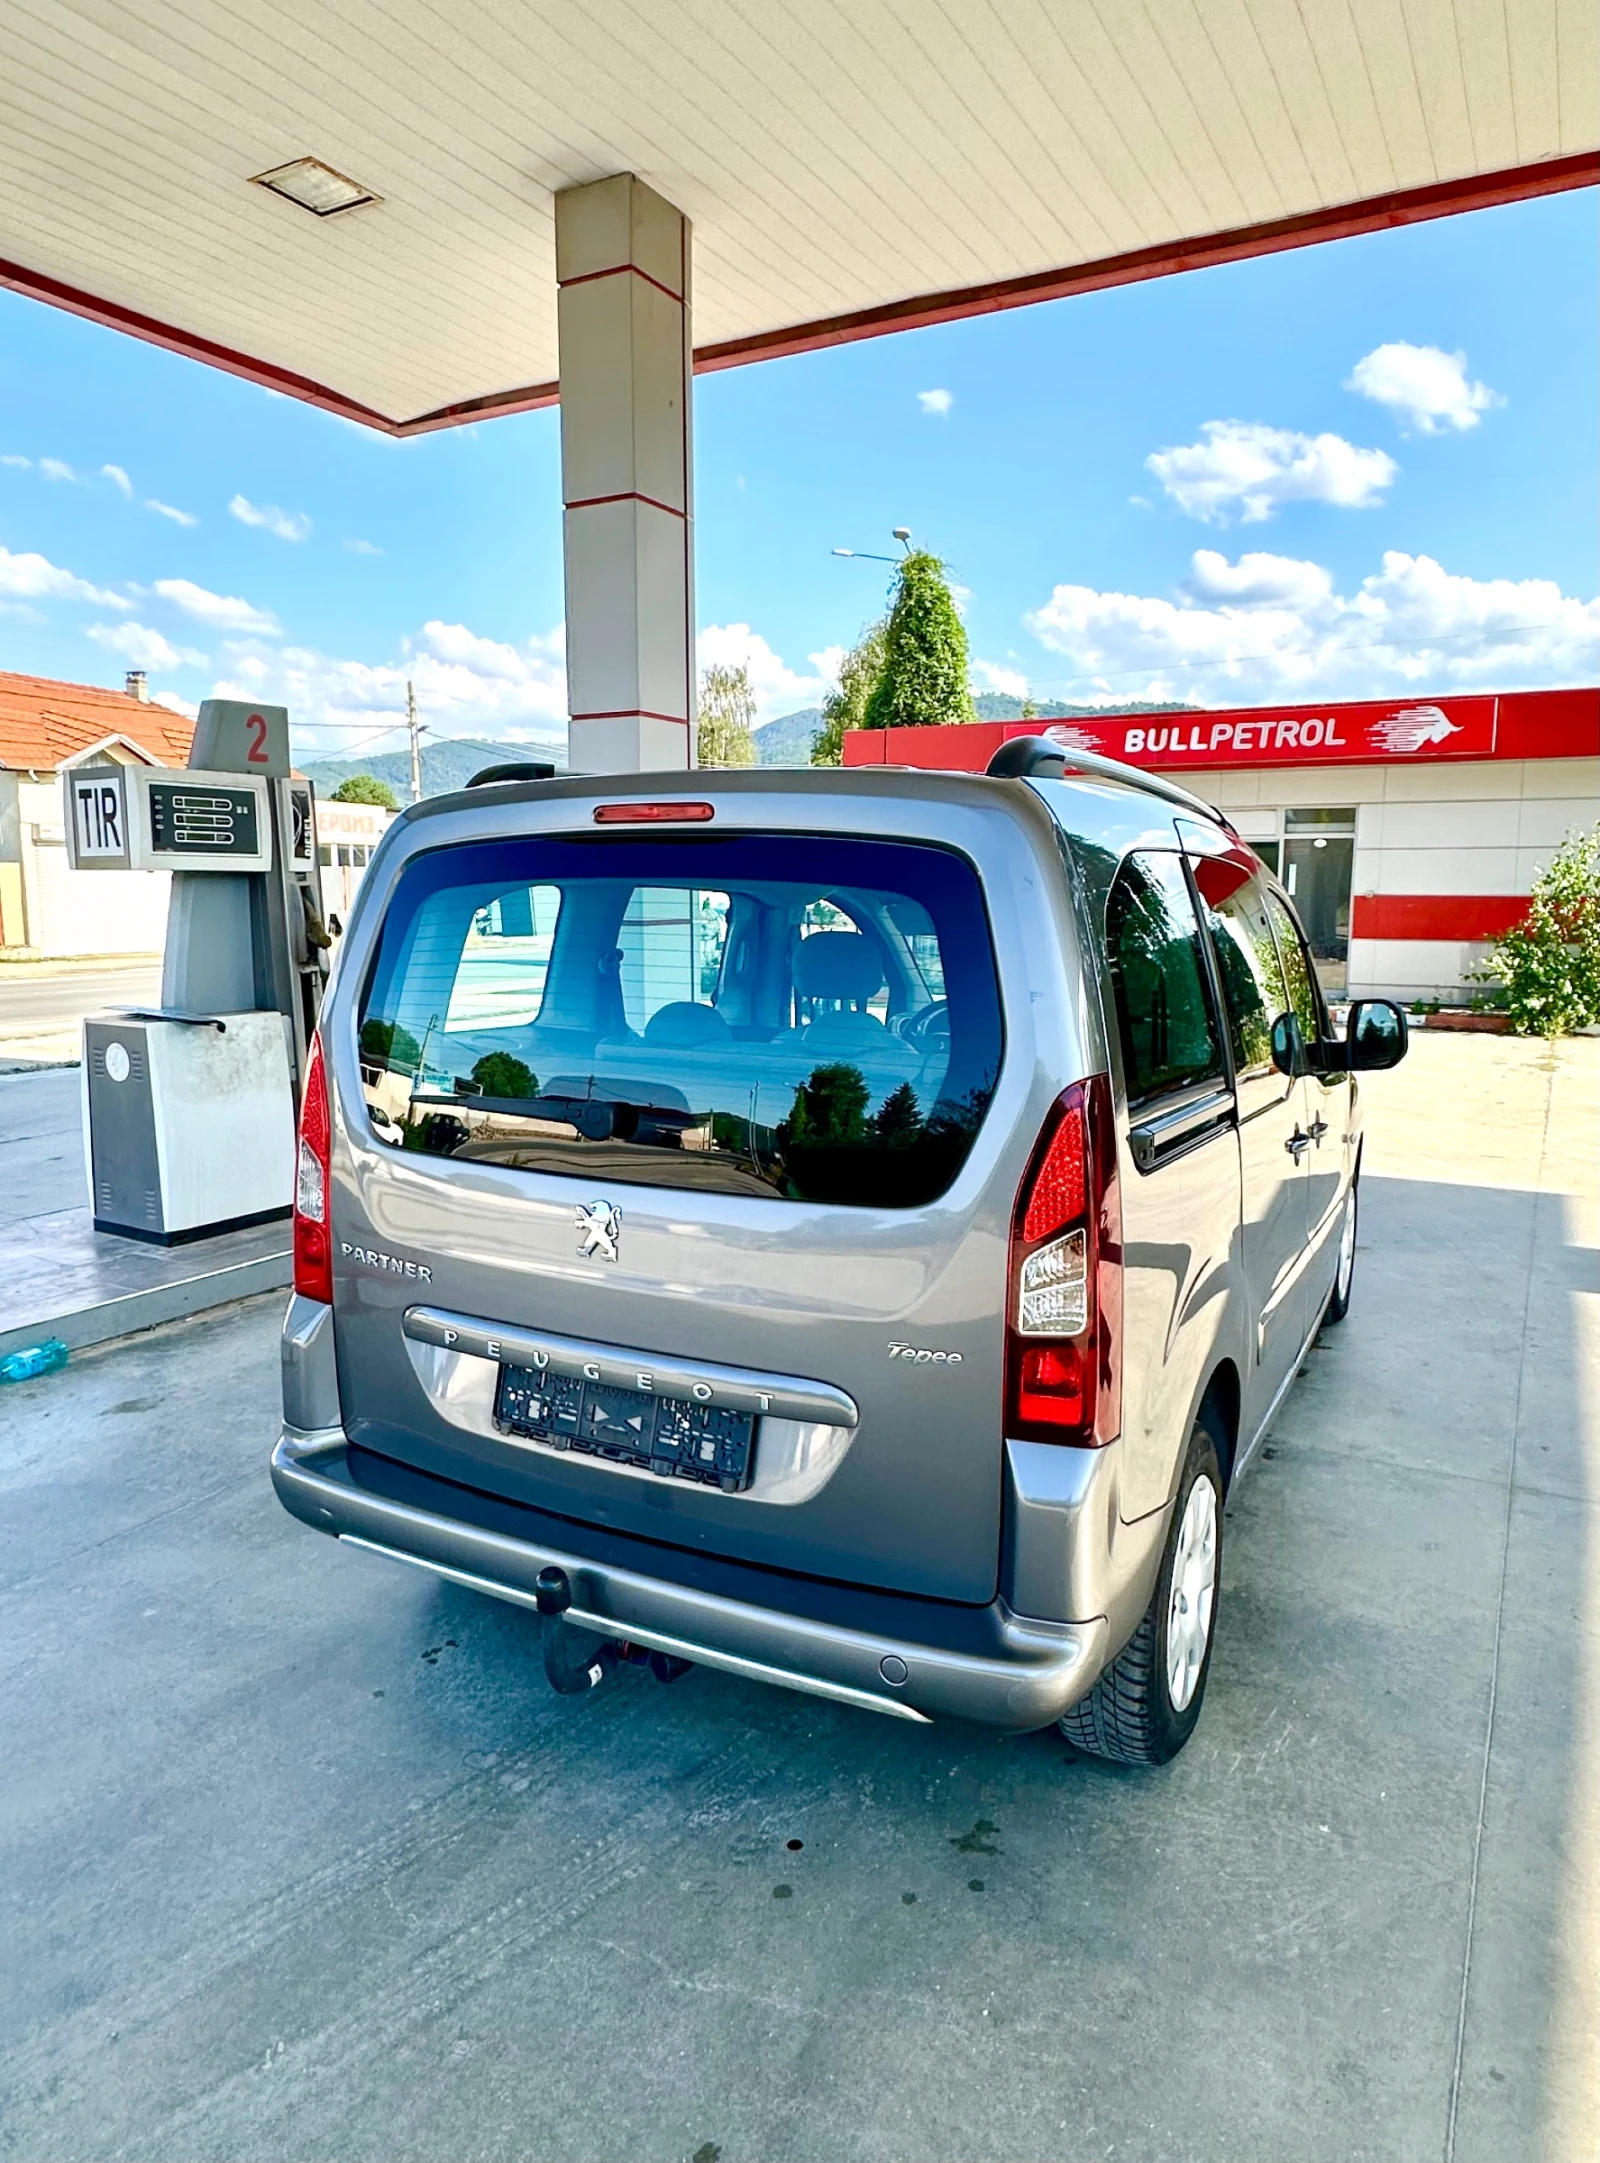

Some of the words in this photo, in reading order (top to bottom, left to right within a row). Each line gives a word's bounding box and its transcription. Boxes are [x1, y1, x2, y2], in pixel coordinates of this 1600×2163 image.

[246, 713, 269, 763] 2
[1124, 718, 1346, 753] BULLPETROL
[78, 787, 122, 849] TIR
[341, 1242, 433, 1284] PARTNER
[443, 1328, 774, 1411] PEUGEOT
[887, 1341, 963, 1366] Tepee
